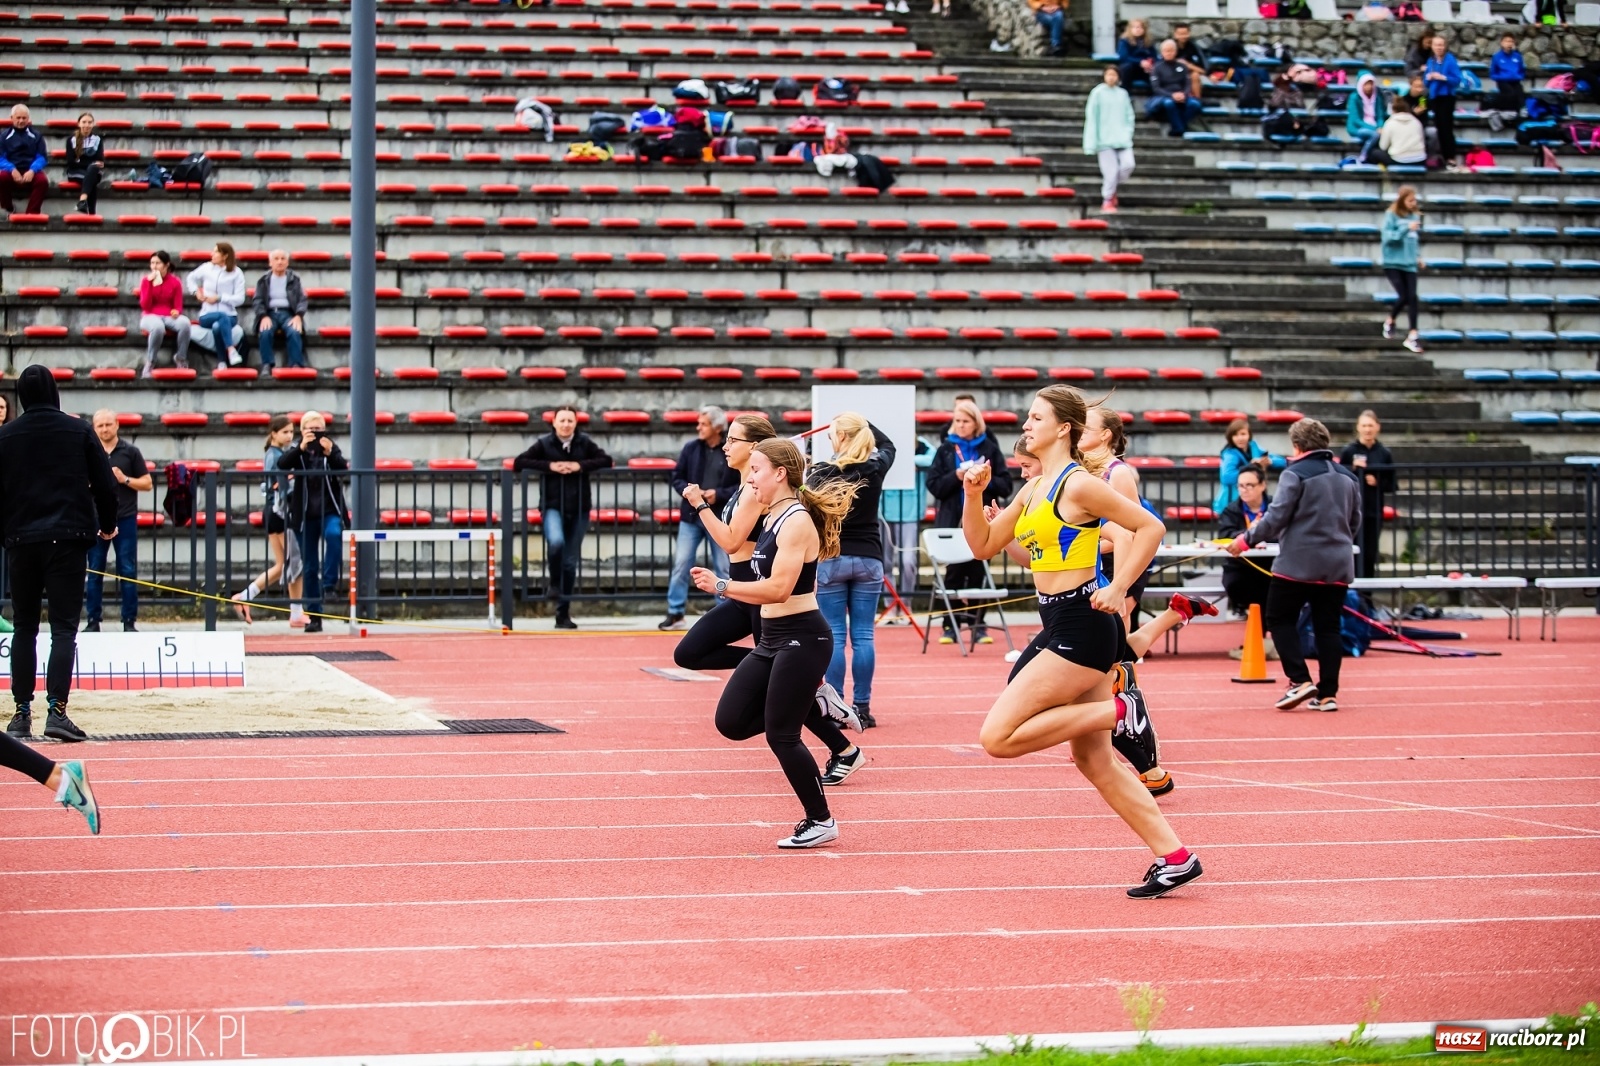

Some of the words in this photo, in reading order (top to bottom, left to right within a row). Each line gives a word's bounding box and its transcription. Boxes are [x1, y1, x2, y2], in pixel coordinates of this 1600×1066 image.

[1082, 580, 1098, 595] NIK
[0, 637, 11, 658] 6
[164, 636, 178, 657] 5
